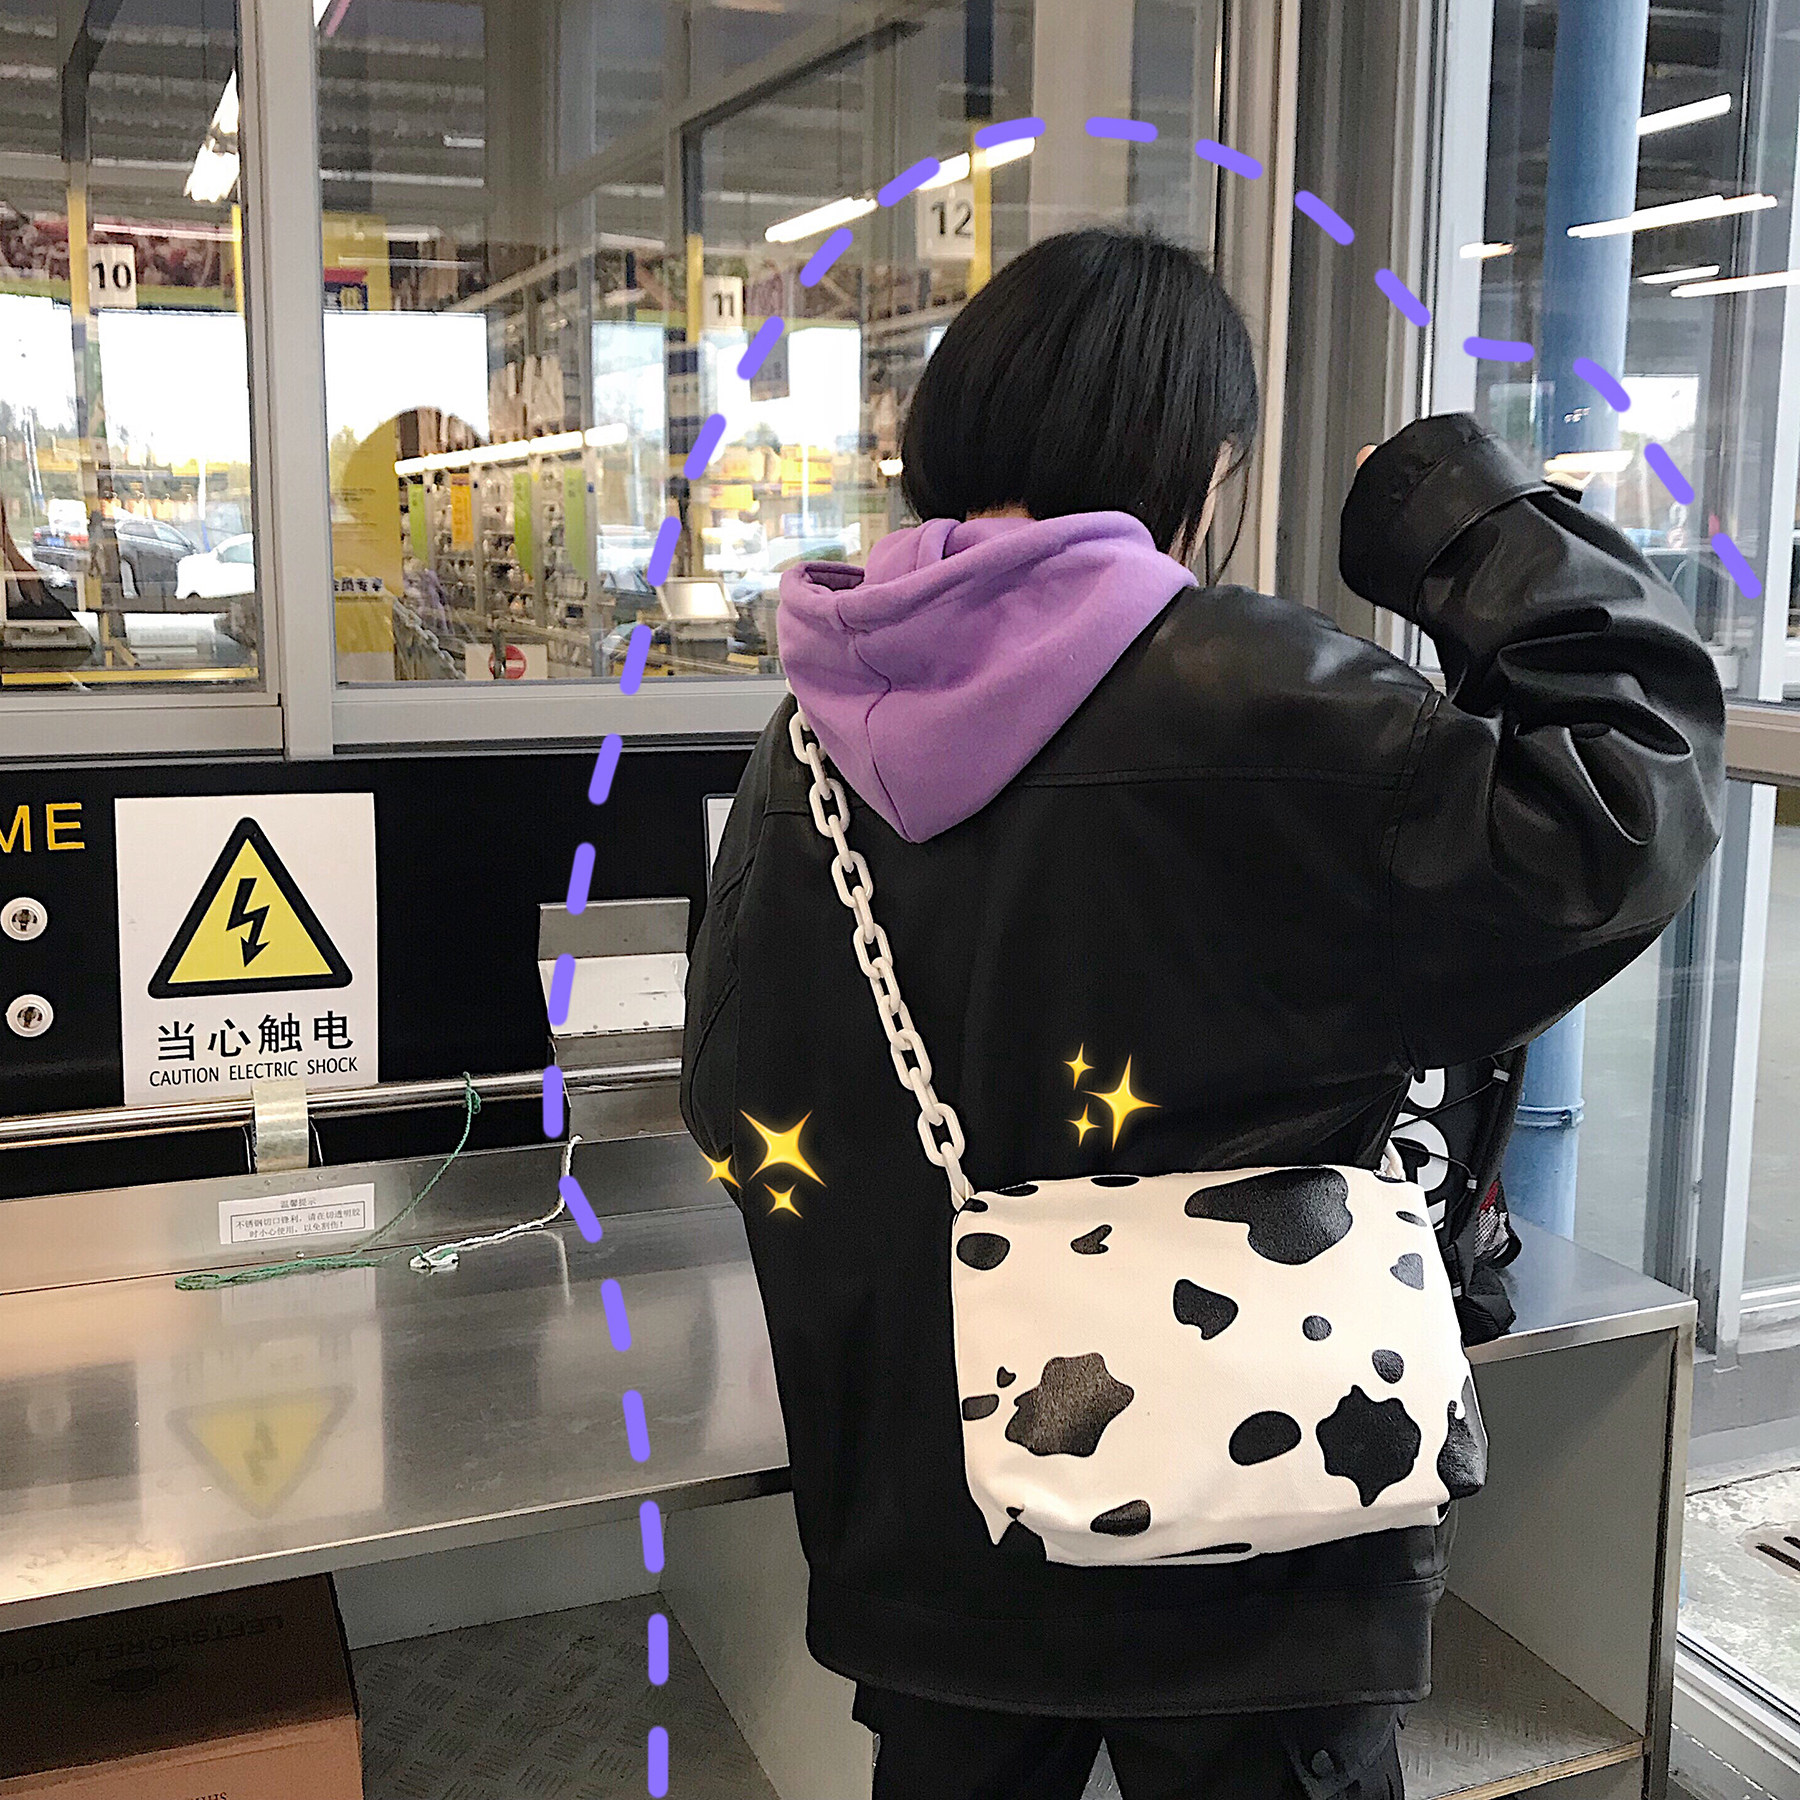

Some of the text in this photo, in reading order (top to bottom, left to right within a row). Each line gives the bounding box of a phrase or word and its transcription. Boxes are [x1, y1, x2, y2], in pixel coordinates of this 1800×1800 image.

[930, 200, 973, 238] 12
[92, 261, 131, 290] 10
[712, 290, 734, 317] 11
[0, 803, 85, 853] ME
[157, 1010, 354, 1061] 当心触电
[149, 1056, 358, 1087] CAUTION ELECTRIC SHOCK
[280, 1197, 317, 1208] 温馨提示
